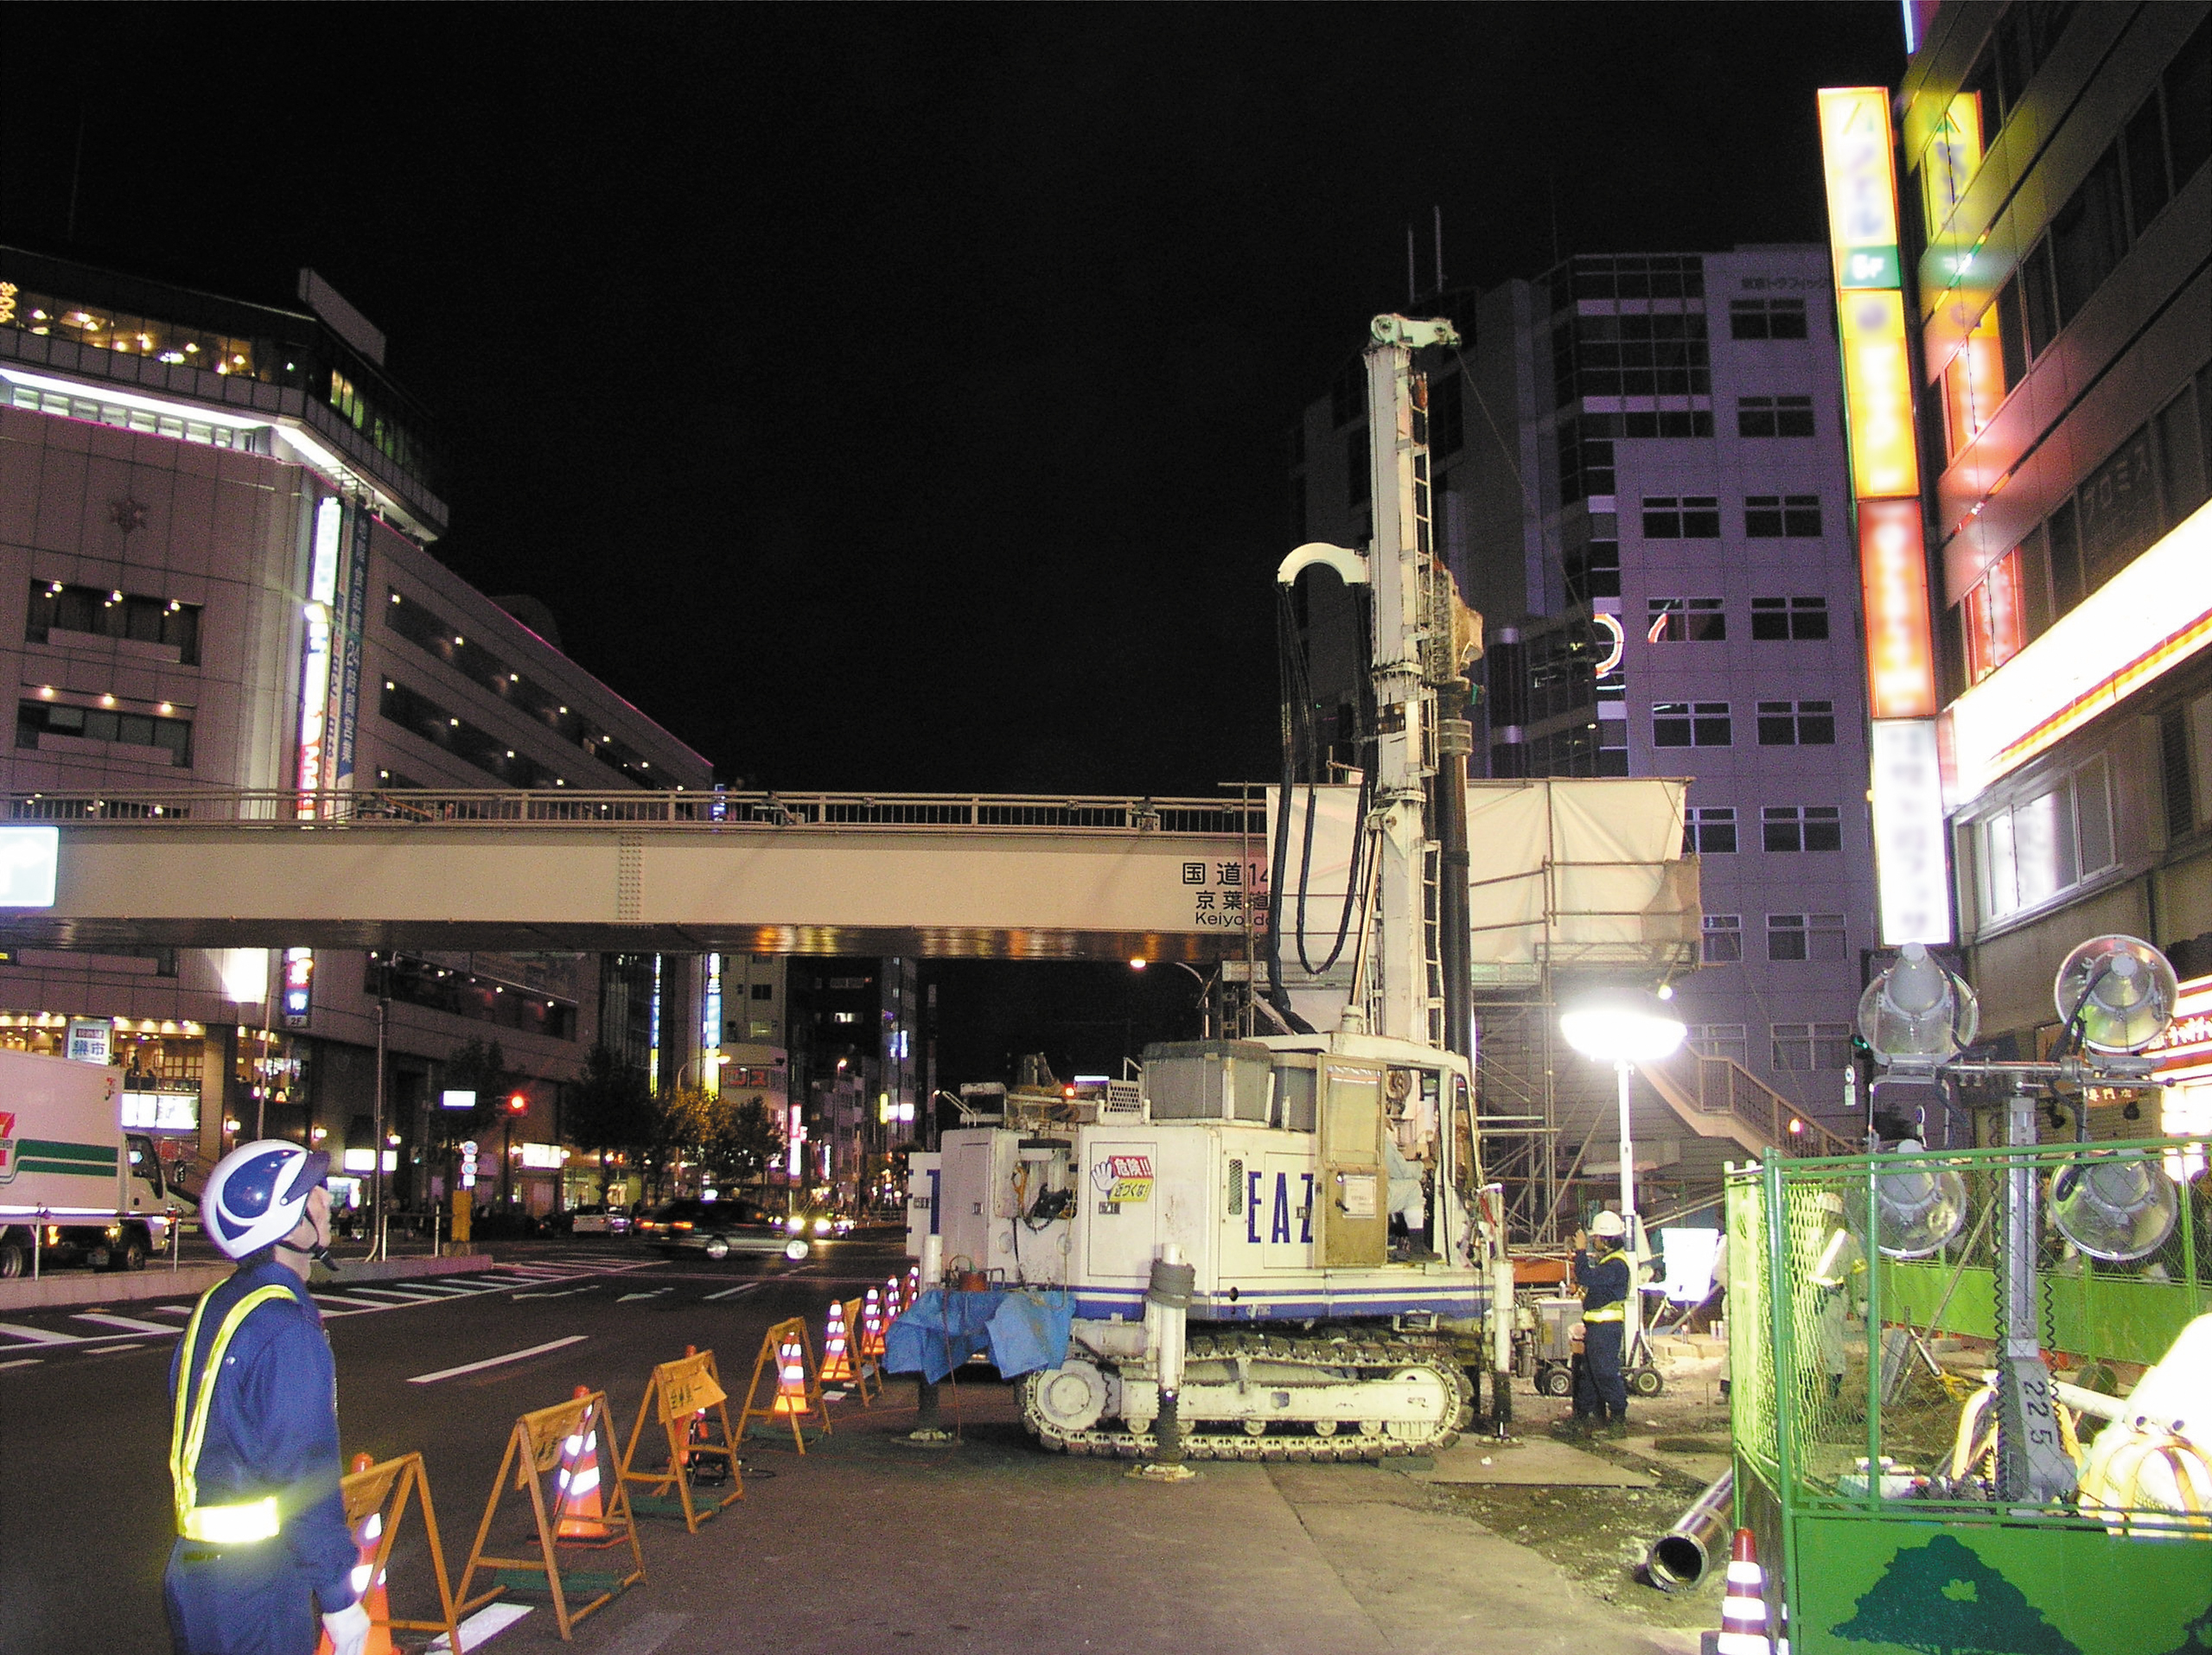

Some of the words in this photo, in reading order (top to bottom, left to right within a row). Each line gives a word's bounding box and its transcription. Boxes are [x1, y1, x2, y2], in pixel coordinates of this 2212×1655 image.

[1195, 911, 1245, 927] Keiyo
[291, 1016, 303, 1027] 2F
[2023, 1380, 2053, 1445] 225
